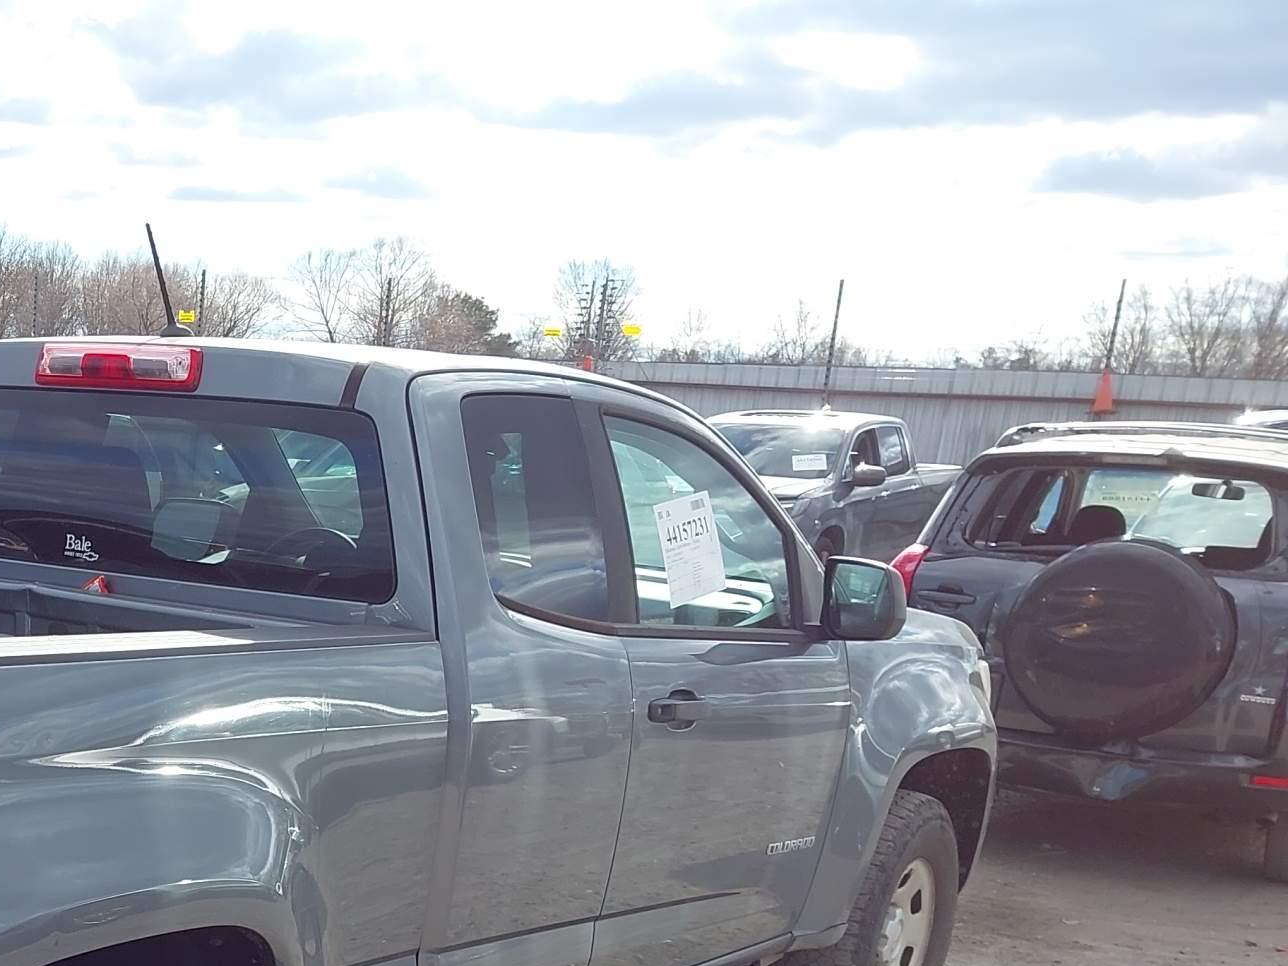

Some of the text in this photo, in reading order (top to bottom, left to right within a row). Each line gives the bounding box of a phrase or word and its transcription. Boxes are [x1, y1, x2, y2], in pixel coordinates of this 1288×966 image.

[666, 516, 710, 545] 44157231
[65, 534, 92, 552] Bale
[767, 836, 815, 855] COLORADO
